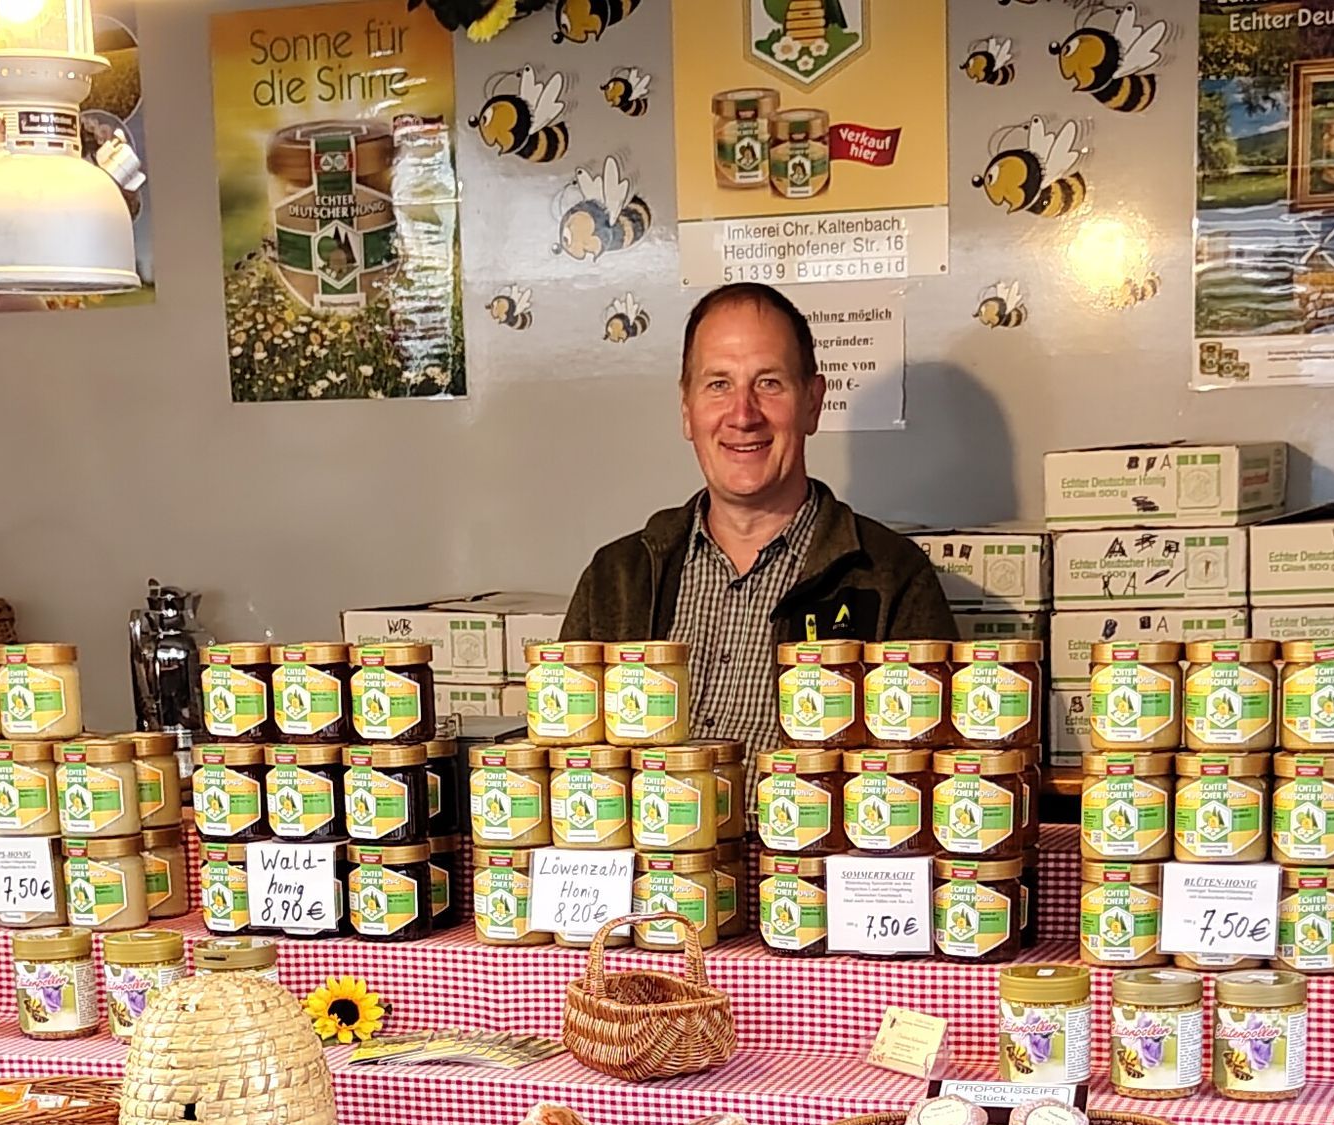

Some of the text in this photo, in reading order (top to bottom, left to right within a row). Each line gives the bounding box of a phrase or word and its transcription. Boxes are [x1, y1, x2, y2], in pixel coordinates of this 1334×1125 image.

[1230, 12, 1294, 32] Echter
[249, 19, 409, 66] Sonne für
[253, 66, 409, 107] die Sinne
[849, 145, 878, 162] hier
[727, 222, 780, 241] Imkerei
[783, 220, 813, 238] Chr.
[723, 235, 904, 261] Heddinghofener Str. 16
[723, 258, 905, 282] 51399 Burscheid
[807, 308, 892, 323] ahlung möglich
[820, 360, 876, 372] hme von
[261, 850, 327, 870] Wald-
[540, 856, 629, 877] Löwenzahn
[841, 871, 916, 880] SOMMERTRACHT
[4, 876, 52, 904] 7,50€
[267, 873, 304, 903] honig
[560, 880, 599, 899] Honig
[866, 915, 919, 940] 7,50€
[1200, 909, 1271, 946] 7,50€
[955, 1084, 1060, 1097] PROPOLISSEIFE
[974, 1093, 1007, 1103] Stück
